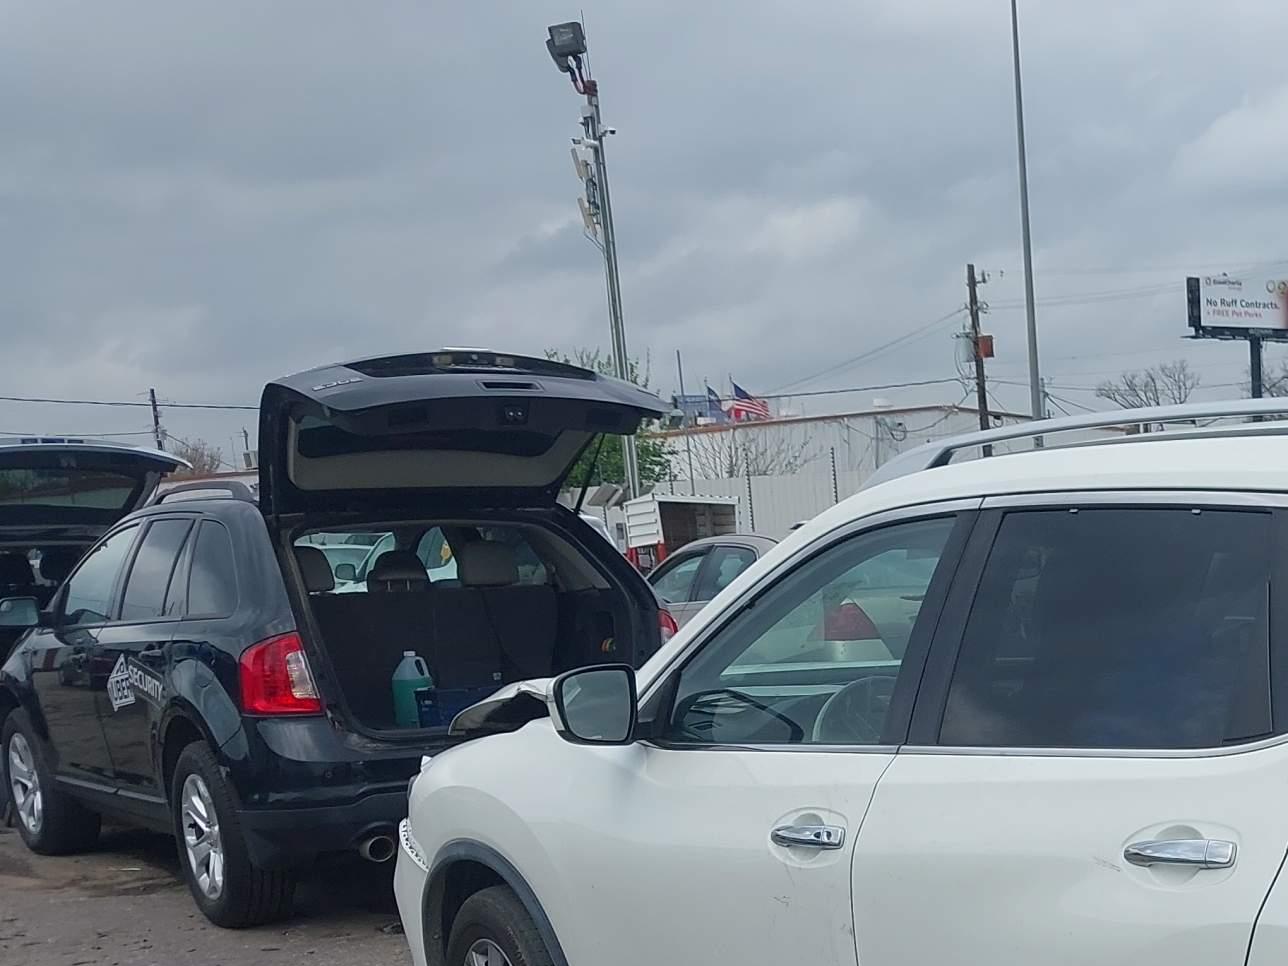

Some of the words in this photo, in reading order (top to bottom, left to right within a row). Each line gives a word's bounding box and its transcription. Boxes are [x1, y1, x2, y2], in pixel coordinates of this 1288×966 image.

[1206, 297, 1217, 307] No
[1220, 298, 1237, 308] Ruff
[128, 665, 163, 701] SECURITY
